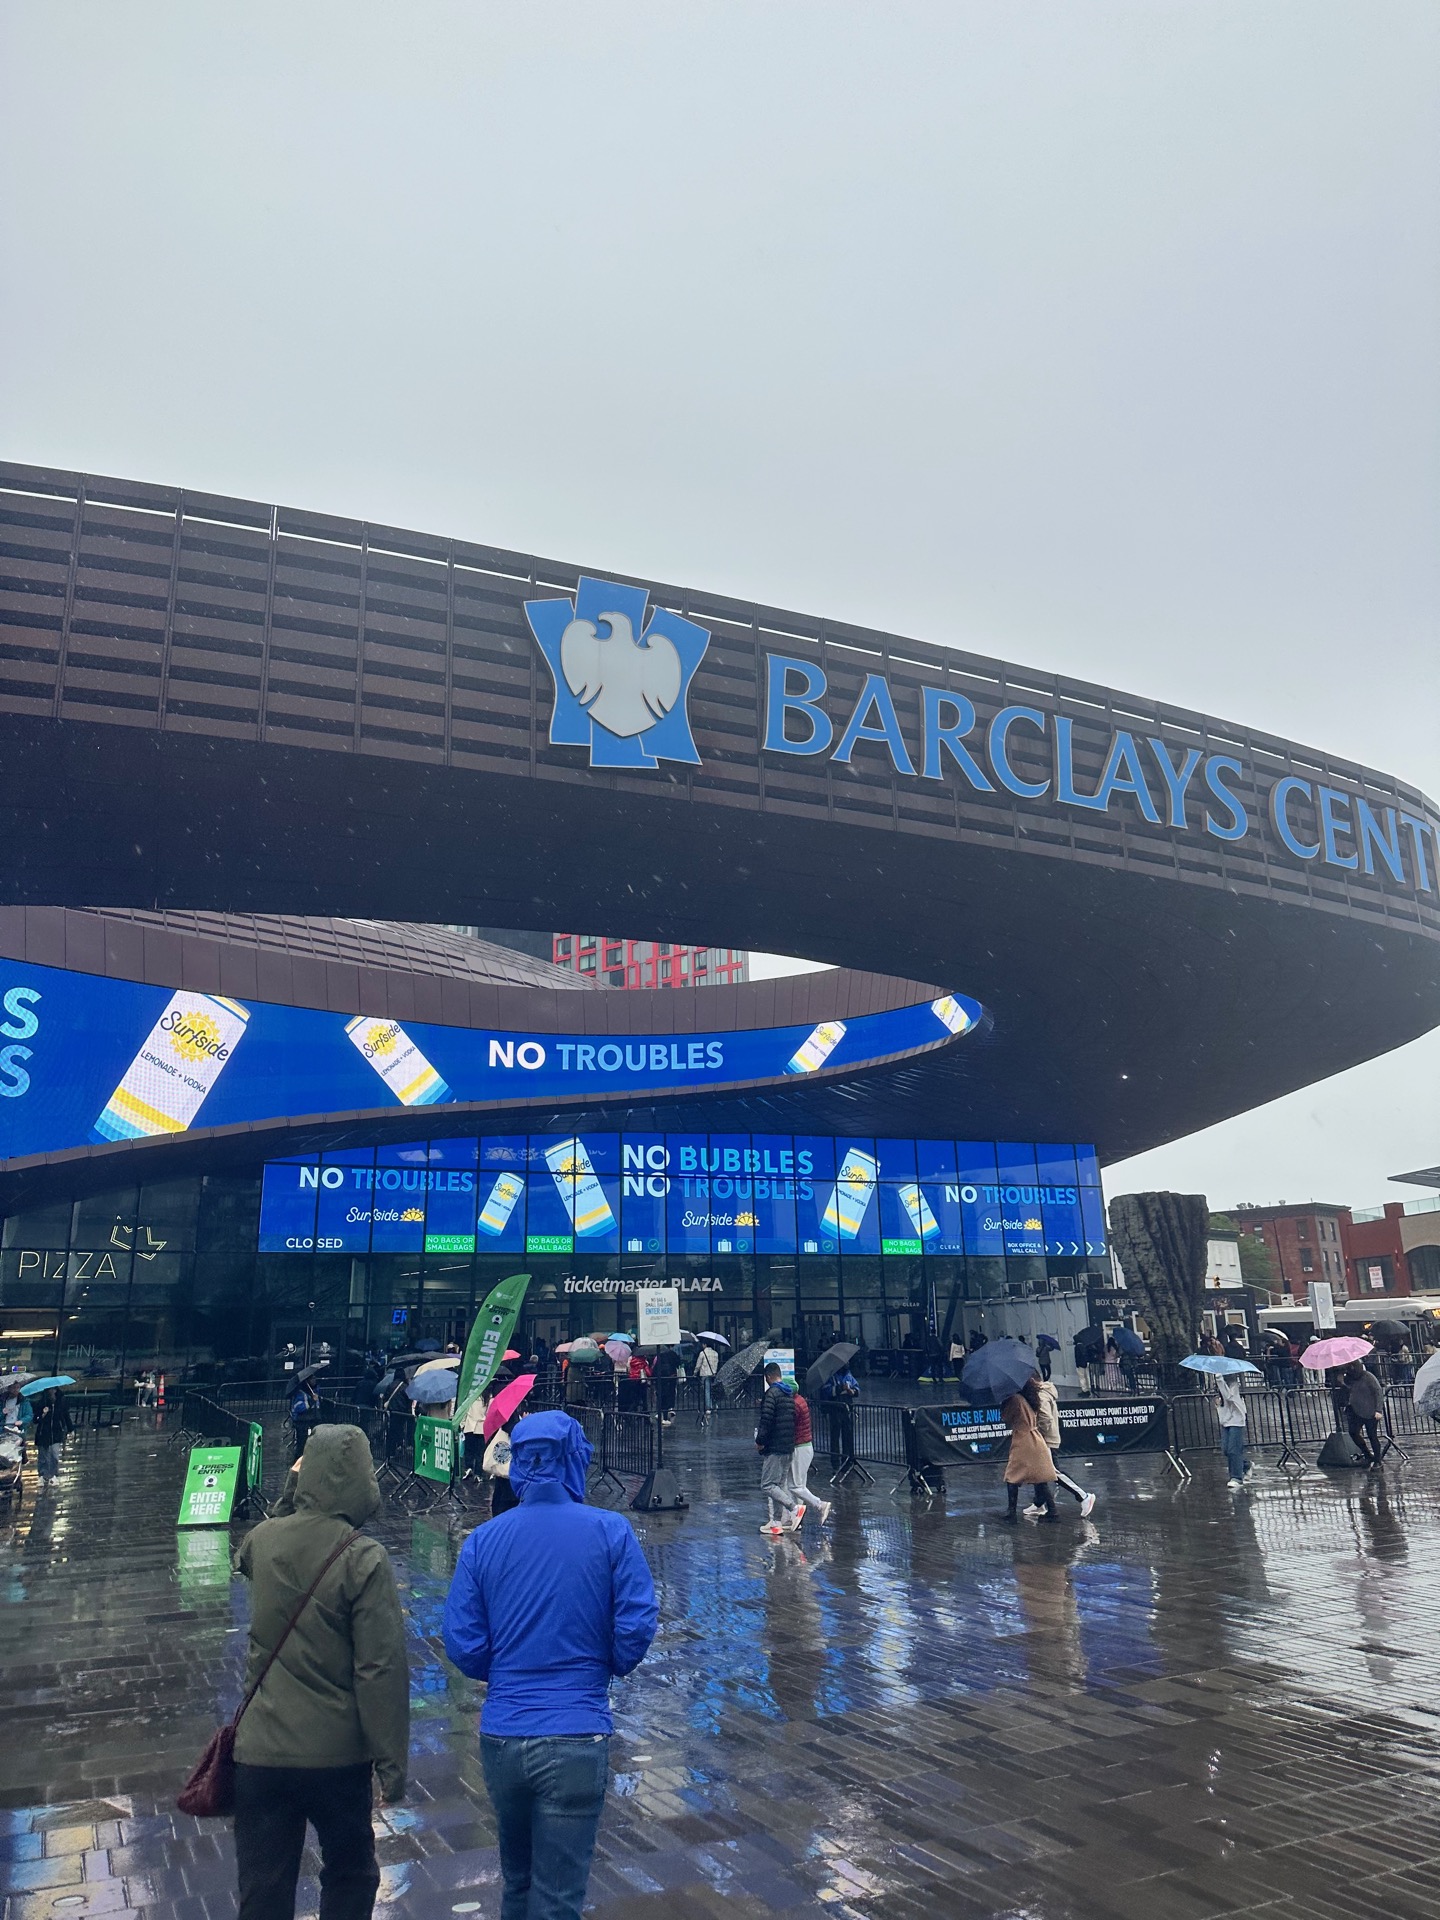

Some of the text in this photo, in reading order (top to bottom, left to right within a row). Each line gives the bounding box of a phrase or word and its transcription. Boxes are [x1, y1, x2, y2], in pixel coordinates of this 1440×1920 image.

[762, 652, 1440, 893] BARCLAYS CENT
[160, 1011, 229, 1061] Surfside
[363, 1023, 401, 1059] Surfside
[488, 1040, 723, 1071] NO TROUBLES
[141, 1050, 178, 1076] LEMONADE
[183, 1075, 207, 1094] VODKA
[623, 1144, 814, 1174] NO BUBBLES
[300, 1166, 473, 1192] NO TROUBLES
[623, 1172, 814, 1200] NO TROUBLES
[945, 1185, 1077, 1205] NO TROUBLES
[346, 1207, 399, 1223] Surfside
[682, 1211, 733, 1227] Surfside
[983, 1217, 1023, 1231] Surfside
[18, 1251, 117, 1279] PIZZA
[564, 1276, 723, 1293] ticketmaster PLAZA
[67, 1344, 95, 1358] FINI
[471, 1329, 501, 1388] ENTER
[942, 1411, 972, 1426] PLEASE
[973, 1410, 984, 1424] BE
[1076, 1408, 1095, 1417] BEYOND
[1096, 1407, 1107, 1416] THIS
[1108, 1407, 1122, 1415] POINT
[1123, 1407, 1128, 1415] IS
[1129, 1406, 1148, 1415] LIMITED
[1148, 1405, 1155, 1413] TO
[1062, 1415, 1148, 1428] TICKET HOLDERS FOR TODAY'S EVENT
[189, 1491, 226, 1504] ENTER
[190, 1503, 221, 1515] HERE
